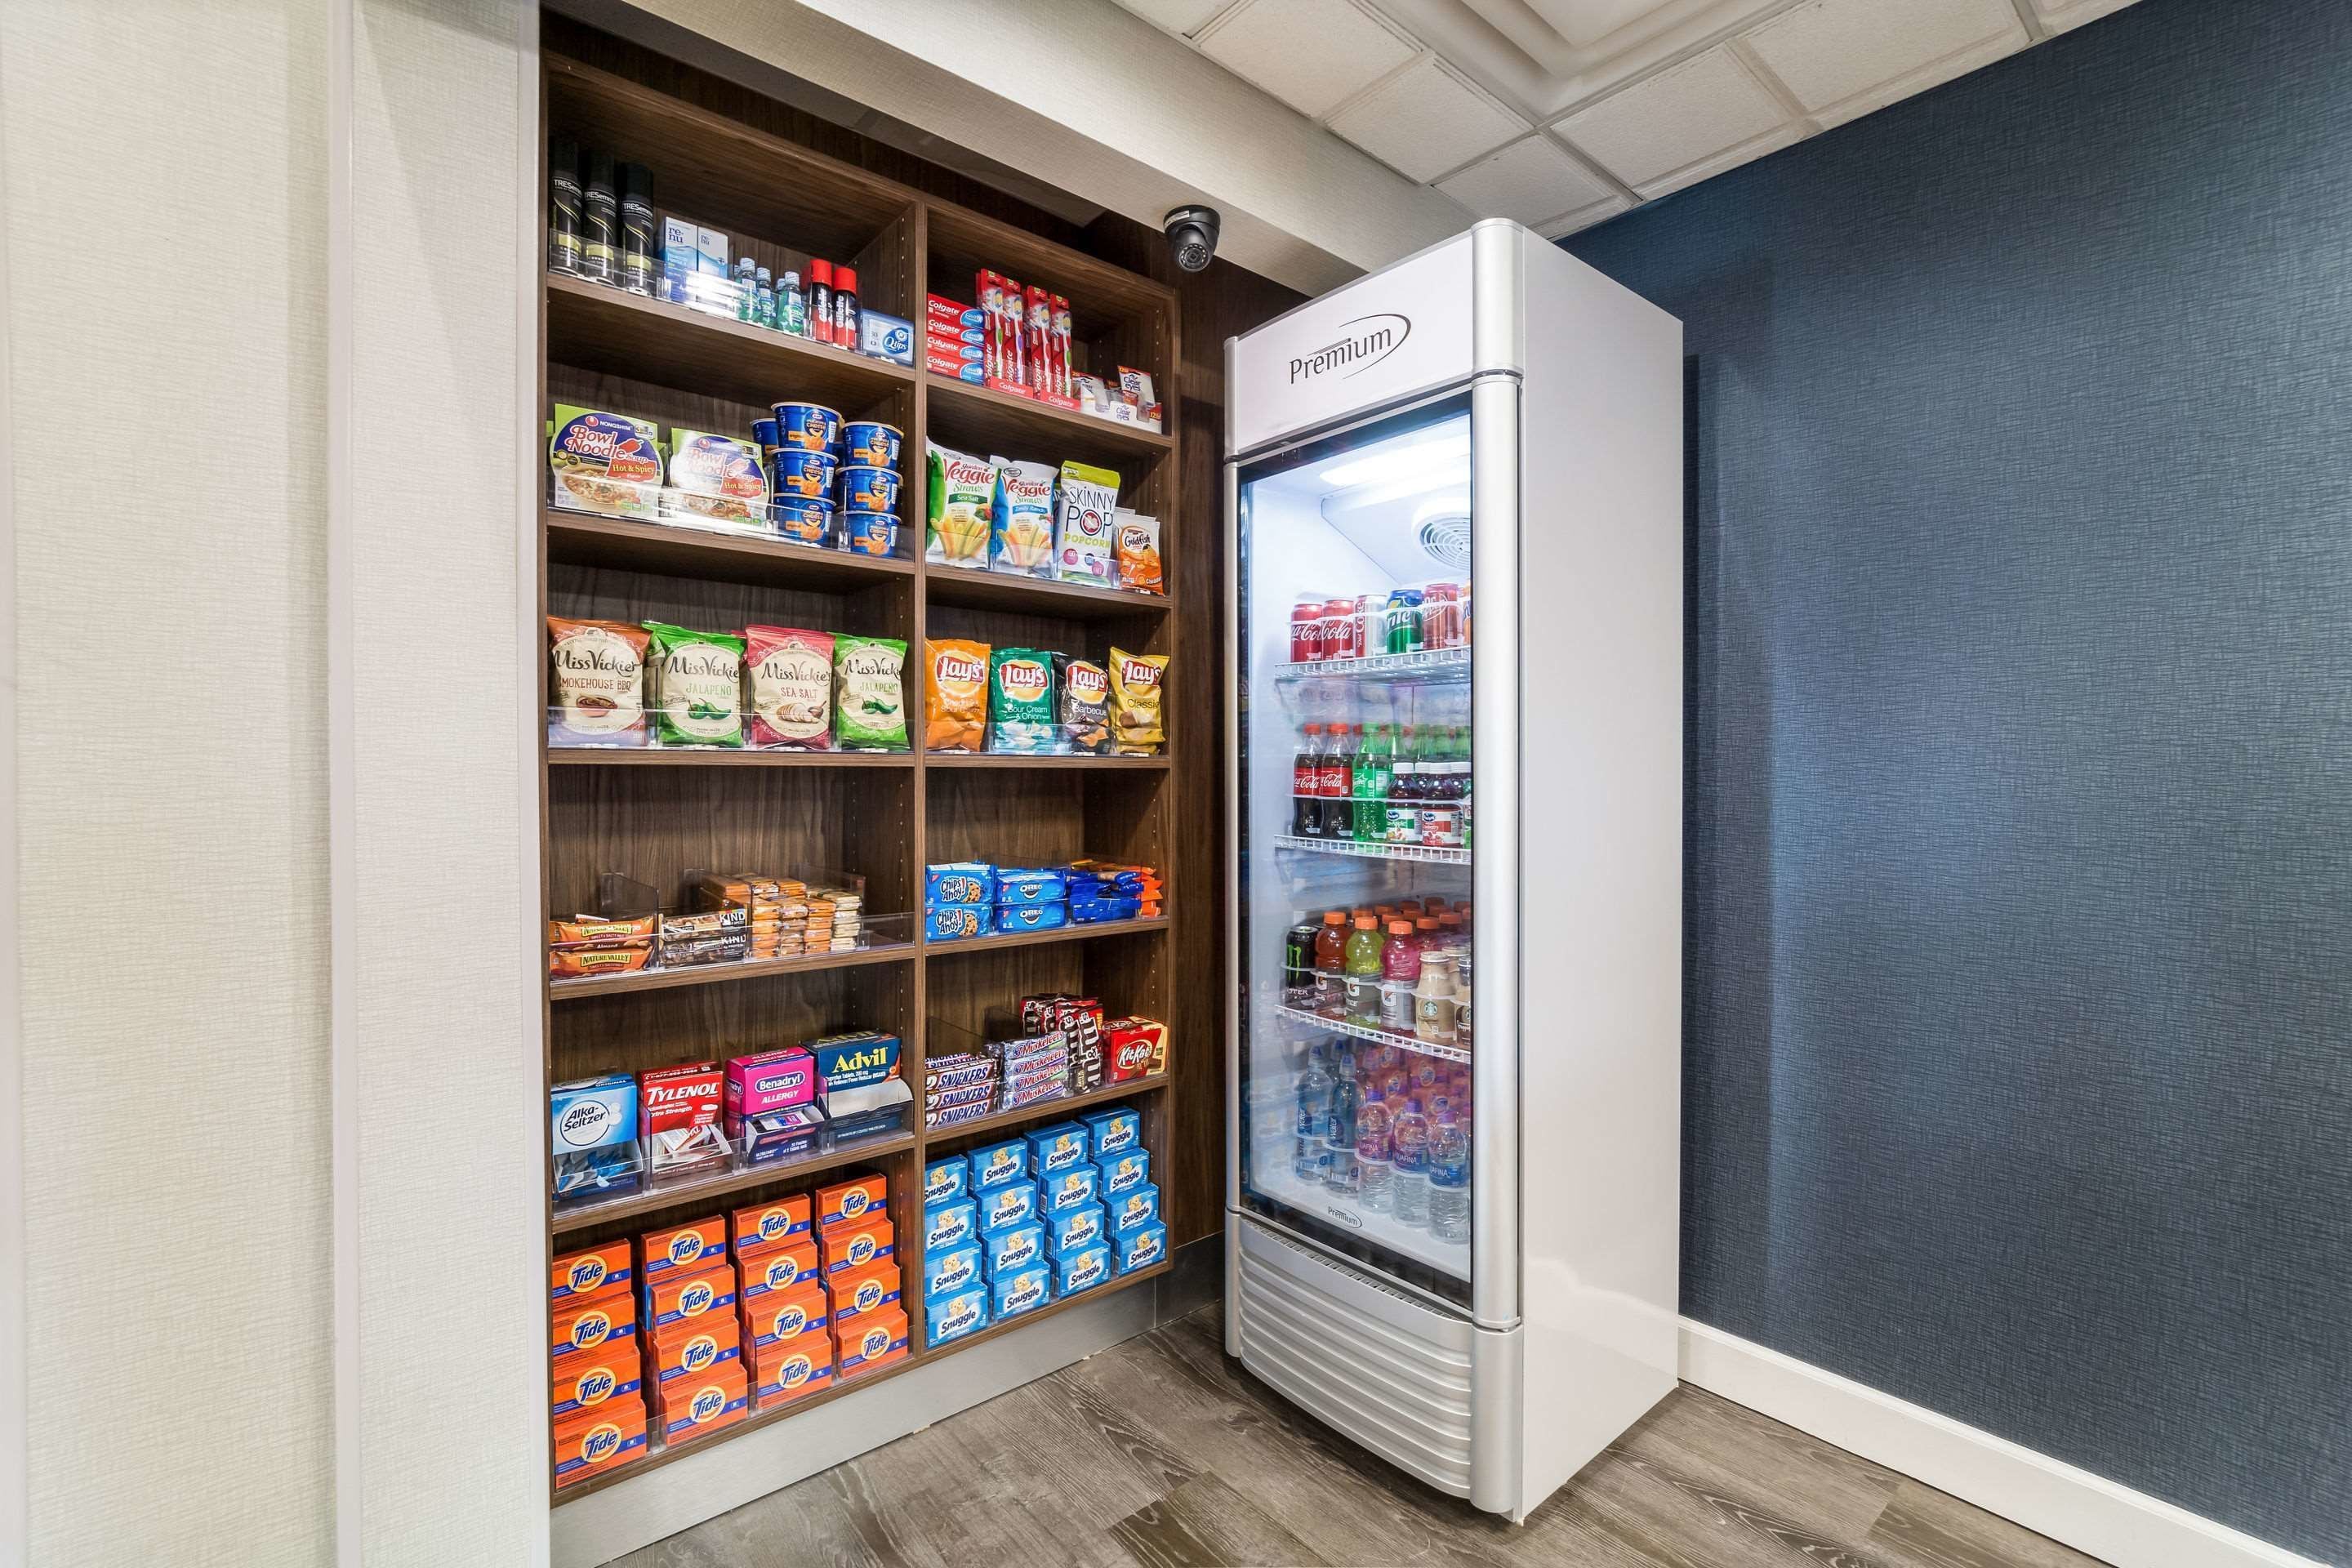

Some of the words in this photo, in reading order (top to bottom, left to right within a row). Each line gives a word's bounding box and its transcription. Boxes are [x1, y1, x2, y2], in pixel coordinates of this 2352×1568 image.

[668, 234, 684, 243] nu
[928, 300, 960, 315] Colgate
[929, 319, 960, 334] Colgate
[927, 336, 959, 351] Colgate
[927, 356, 959, 370] Colgate
[1290, 328, 1391, 385] Premium
[999, 381, 1027, 396] Colgate
[1124, 376, 1142, 386] Clear
[1125, 383, 1141, 392] eyes
[1049, 395, 1075, 408] Colgate
[570, 425, 618, 445] Bowl
[564, 438, 626, 460] Noodle
[635, 466, 655, 474] Spicy
[943, 458, 995, 485] Veggie
[1002, 475, 1051, 497] Veggie
[1066, 506, 1114, 539] POP
[1064, 533, 1111, 549] POPCORN
[1125, 533, 1151, 548] Goldfish
[938, 656, 985, 683] Lay's
[1002, 663, 1048, 688] Lay's
[1067, 666, 1107, 693] Lay's
[1124, 658, 1160, 685] Lay's
[617, 679, 632, 692] BBQ
[781, 687, 798, 697] SEA
[800, 688, 818, 699] SALT
[1022, 713, 1042, 721] Onion
[1027, 705, 1048, 713] Cream
[941, 879, 961, 893] Chips
[1020, 884, 1043, 892] OREO
[719, 912, 746, 925] KIND
[937, 912, 958, 925] Chips
[721, 934, 746, 945] KIND
[1022, 1031, 1063, 1056] Musketeers
[831, 1046, 888, 1074] Advil
[1022, 1049, 1065, 1071] Musketeers
[760, 1074, 800, 1090] Benadryl
[939, 1066, 988, 1088] SNICKERS
[1023, 1065, 1064, 1089] Musketeers
[647, 1082, 719, 1107] TYLENOL
[761, 1090, 800, 1104] ALLERGY
[940, 1085, 990, 1107] SNICKERS
[1022, 1080, 1062, 1104] Musketeers
[567, 1107, 599, 1122] Alka-
[665, 1105, 693, 1115] Strength
[939, 1102, 987, 1125] SNICKERS
[564, 1111, 607, 1132] Seltzer
[1104, 1129, 1131, 1149] Snuggle
[1049, 1147, 1078, 1166] Snuggle
[986, 1160, 1017, 1181] Snuggle
[1112, 1169, 1140, 1189] Snuggle
[924, 1179, 956, 1201] Snuggle
[1058, 1186, 1089, 1205] Snuggle
[843, 1194, 866, 1215] Tide
[993, 1202, 1026, 1224] Snuggle
[760, 1215, 788, 1237] Tide
[1121, 1206, 1151, 1227] Snuggle
[1328, 1205, 1357, 1226] Premium
[929, 1223, 964, 1245] Snuggle
[1064, 1225, 1094, 1246] Snuggle
[672, 1238, 701, 1262] Tide
[850, 1241, 874, 1262] Tide
[1000, 1245, 1033, 1267] Snuggle
[1129, 1244, 1159, 1265] Snuggle
[572, 1264, 604, 1289] Tide
[768, 1264, 795, 1286] Tide
[934, 1267, 970, 1290] Snuggle
[1071, 1264, 1101, 1286] Snuggle
[682, 1290, 711, 1315] Tide
[857, 1286, 881, 1307] Tide
[1006, 1287, 1040, 1309] Snuggle
[777, 1313, 804, 1335] Tide
[941, 1310, 977, 1334] Snuggle
[575, 1321, 607, 1346] Tide
[863, 1334, 889, 1356] Tide
[685, 1344, 715, 1369] Tide
[781, 1361, 809, 1384] Tide
[579, 1376, 612, 1403] Tide
[693, 1396, 723, 1420] Tide
[584, 1432, 617, 1459] Tide
